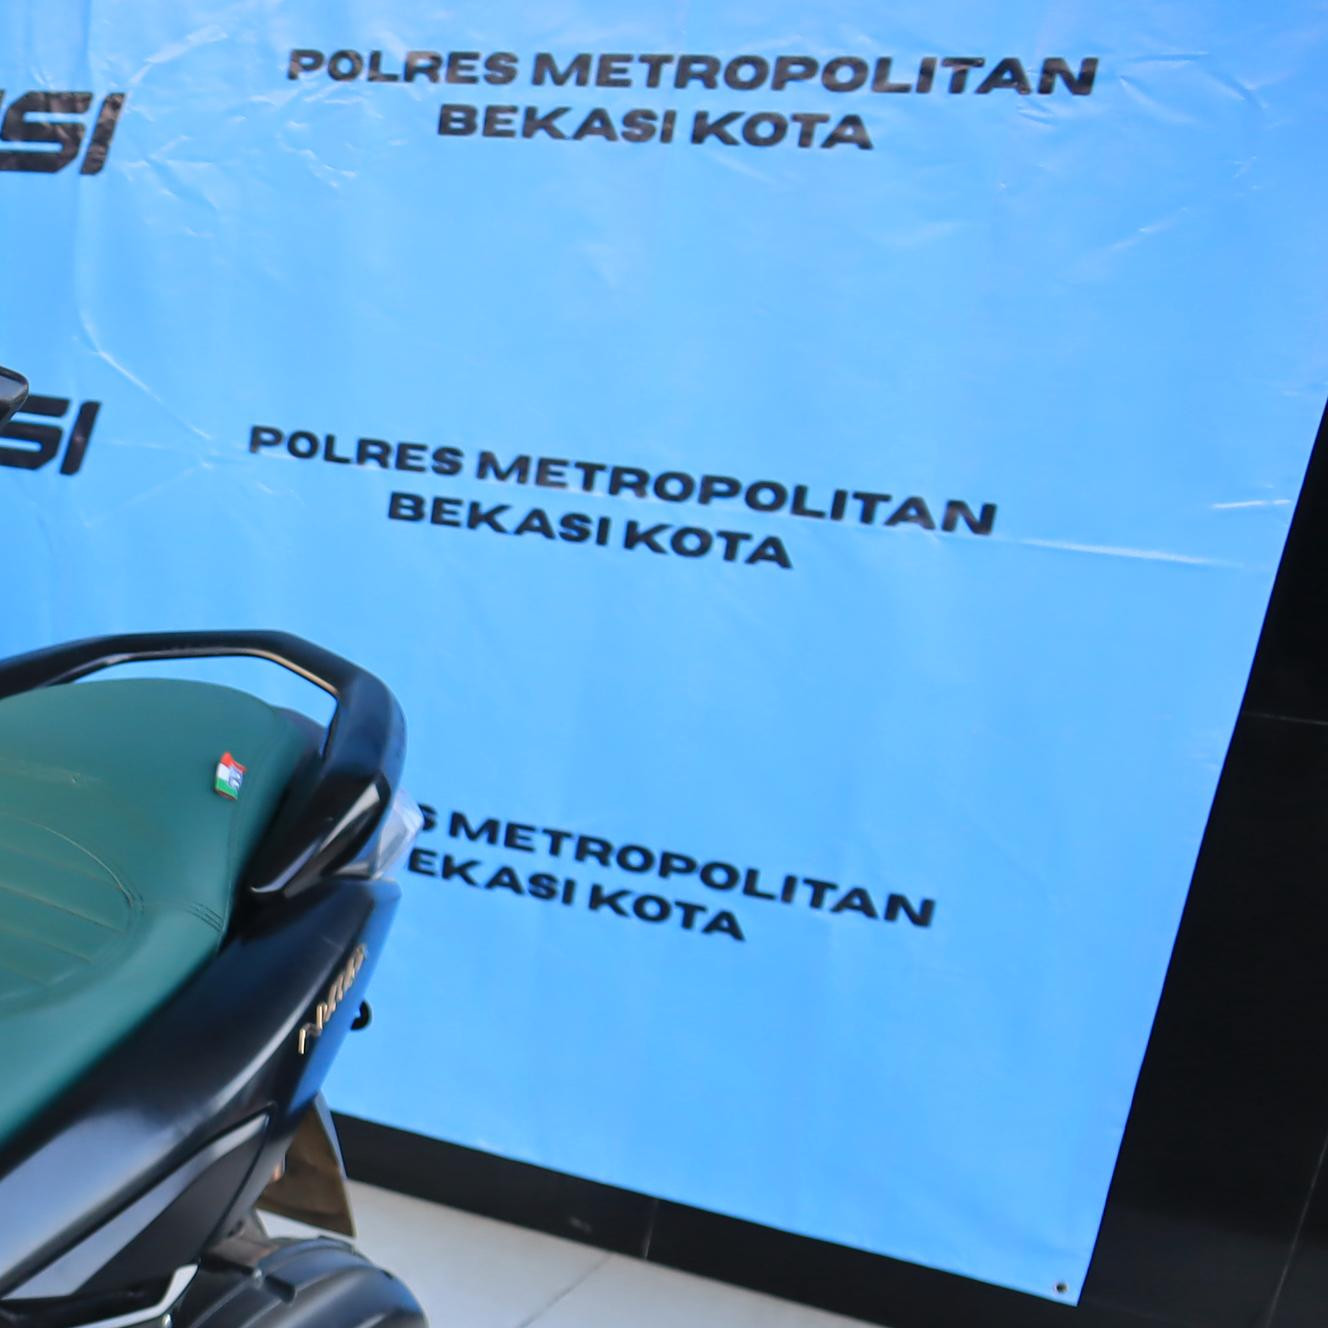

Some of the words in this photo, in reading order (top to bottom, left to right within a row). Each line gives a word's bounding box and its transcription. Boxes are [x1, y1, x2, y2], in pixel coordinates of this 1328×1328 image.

[287, 48, 519, 86] POLRES
[531, 51, 1100, 96] METROPOLITAN
[437, 103, 677, 144] BEKASI
[690, 109, 875, 151] KOTA
[248, 425, 465, 477] POLRES
[475, 450, 999, 537] METROPOLITAN
[387, 491, 612, 547] BEKASI
[623, 520, 795, 570] KOTA
[407, 846, 577, 907] EKASI
[588, 882, 747, 943] KOTA
[448, 809, 937, 929] METROPOLITAN
